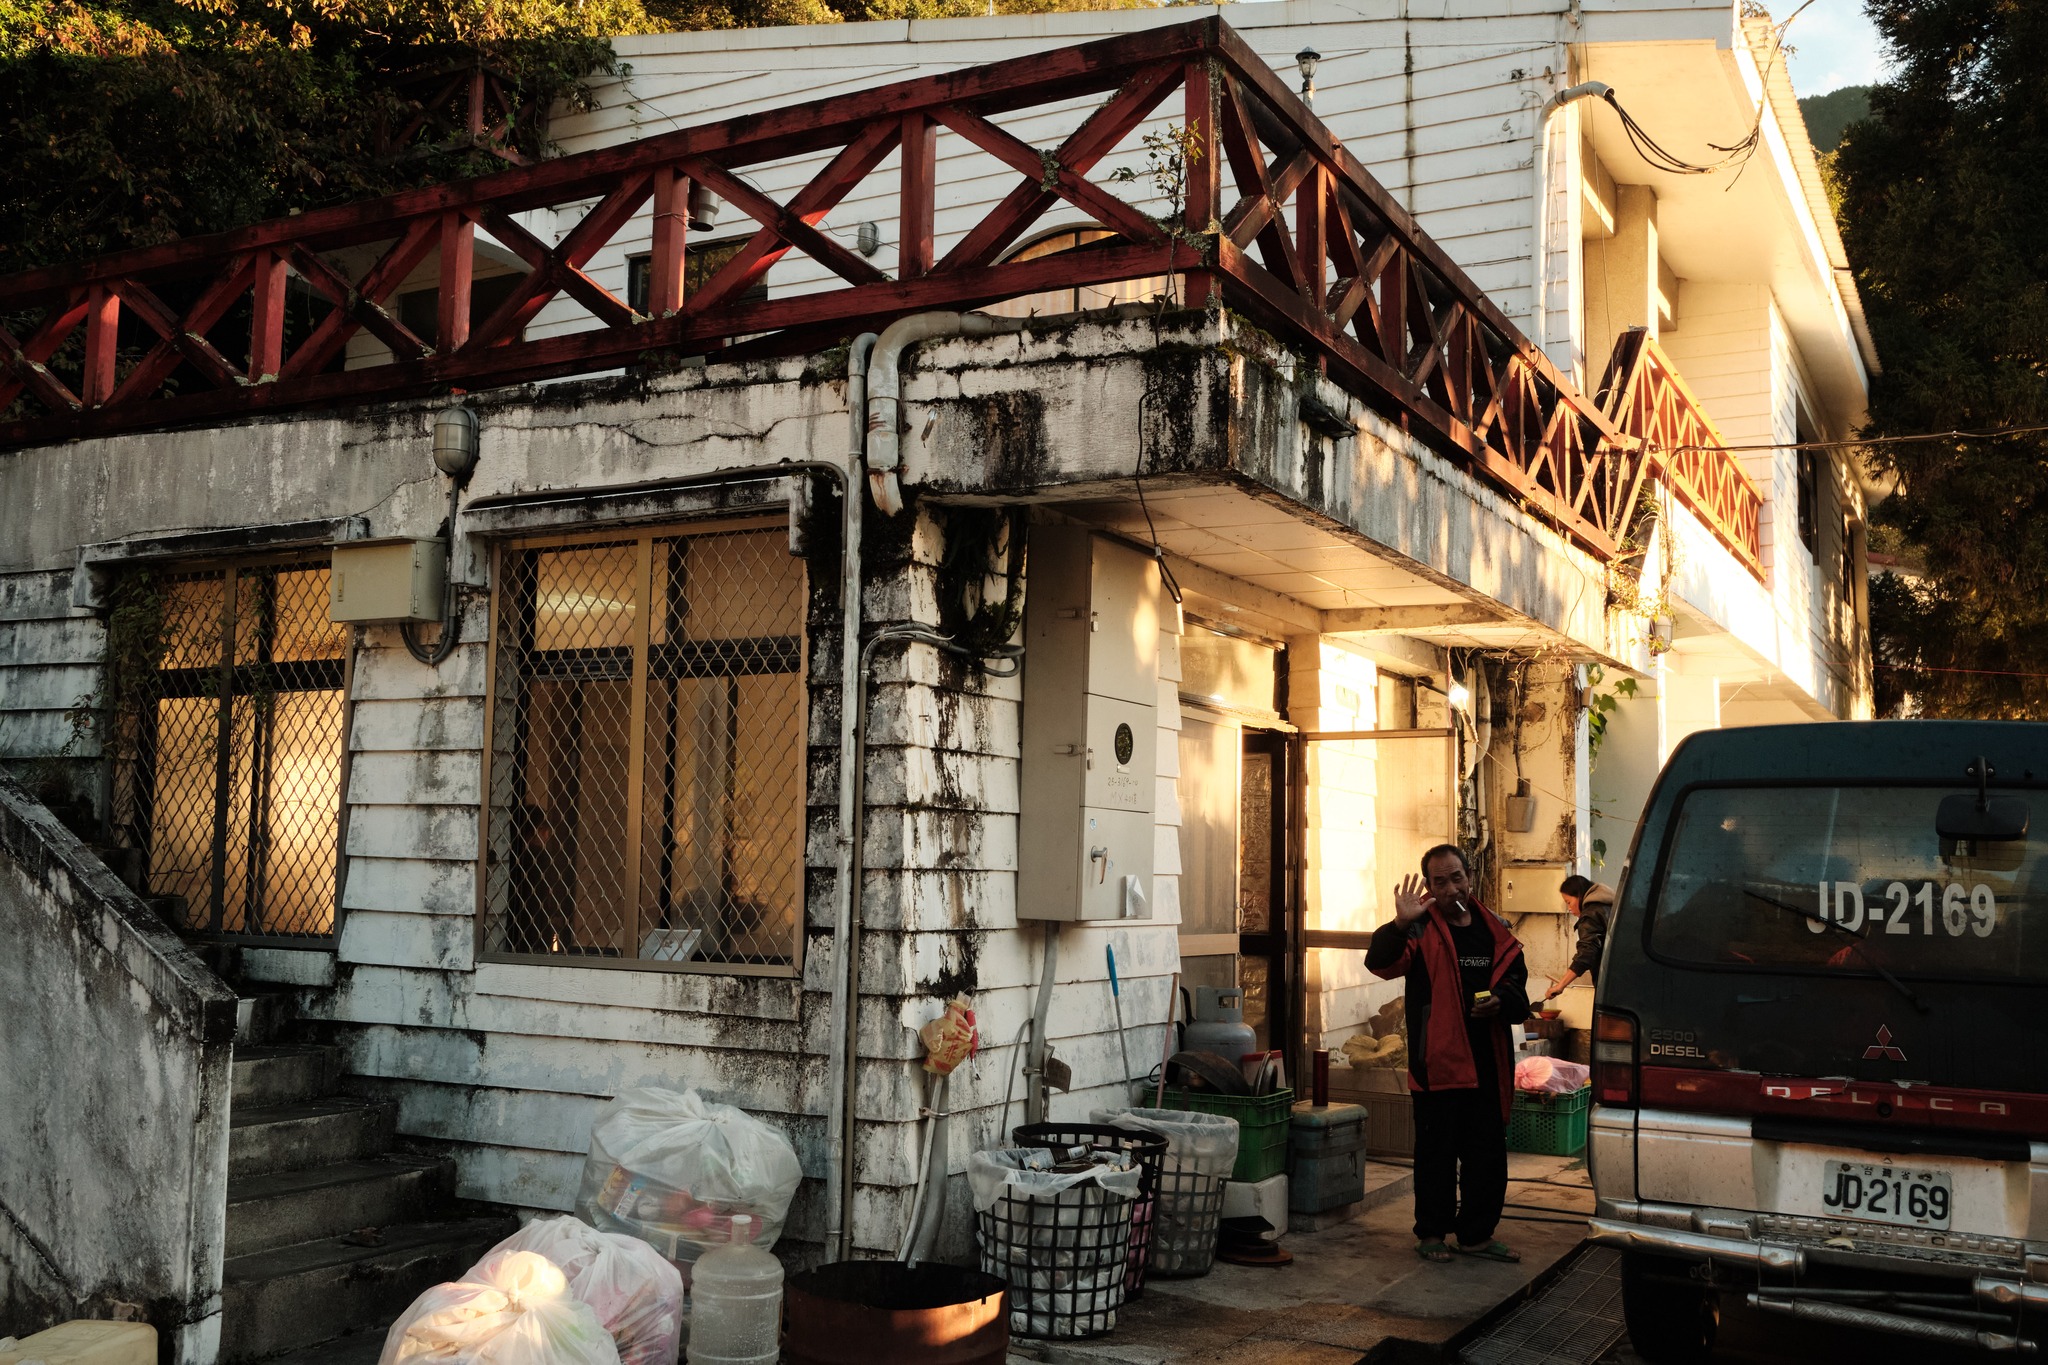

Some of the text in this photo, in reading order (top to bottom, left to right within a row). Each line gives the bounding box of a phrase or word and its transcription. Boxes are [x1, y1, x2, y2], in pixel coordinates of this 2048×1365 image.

[1806, 881, 1996, 938] JD-2169
[1459, 958, 1490, 967] TONIGHT
[1651, 1029, 1695, 1043] 2500
[1650, 1043, 1706, 1058] DIESEL
[1766, 1086, 2006, 1115] DELICA
